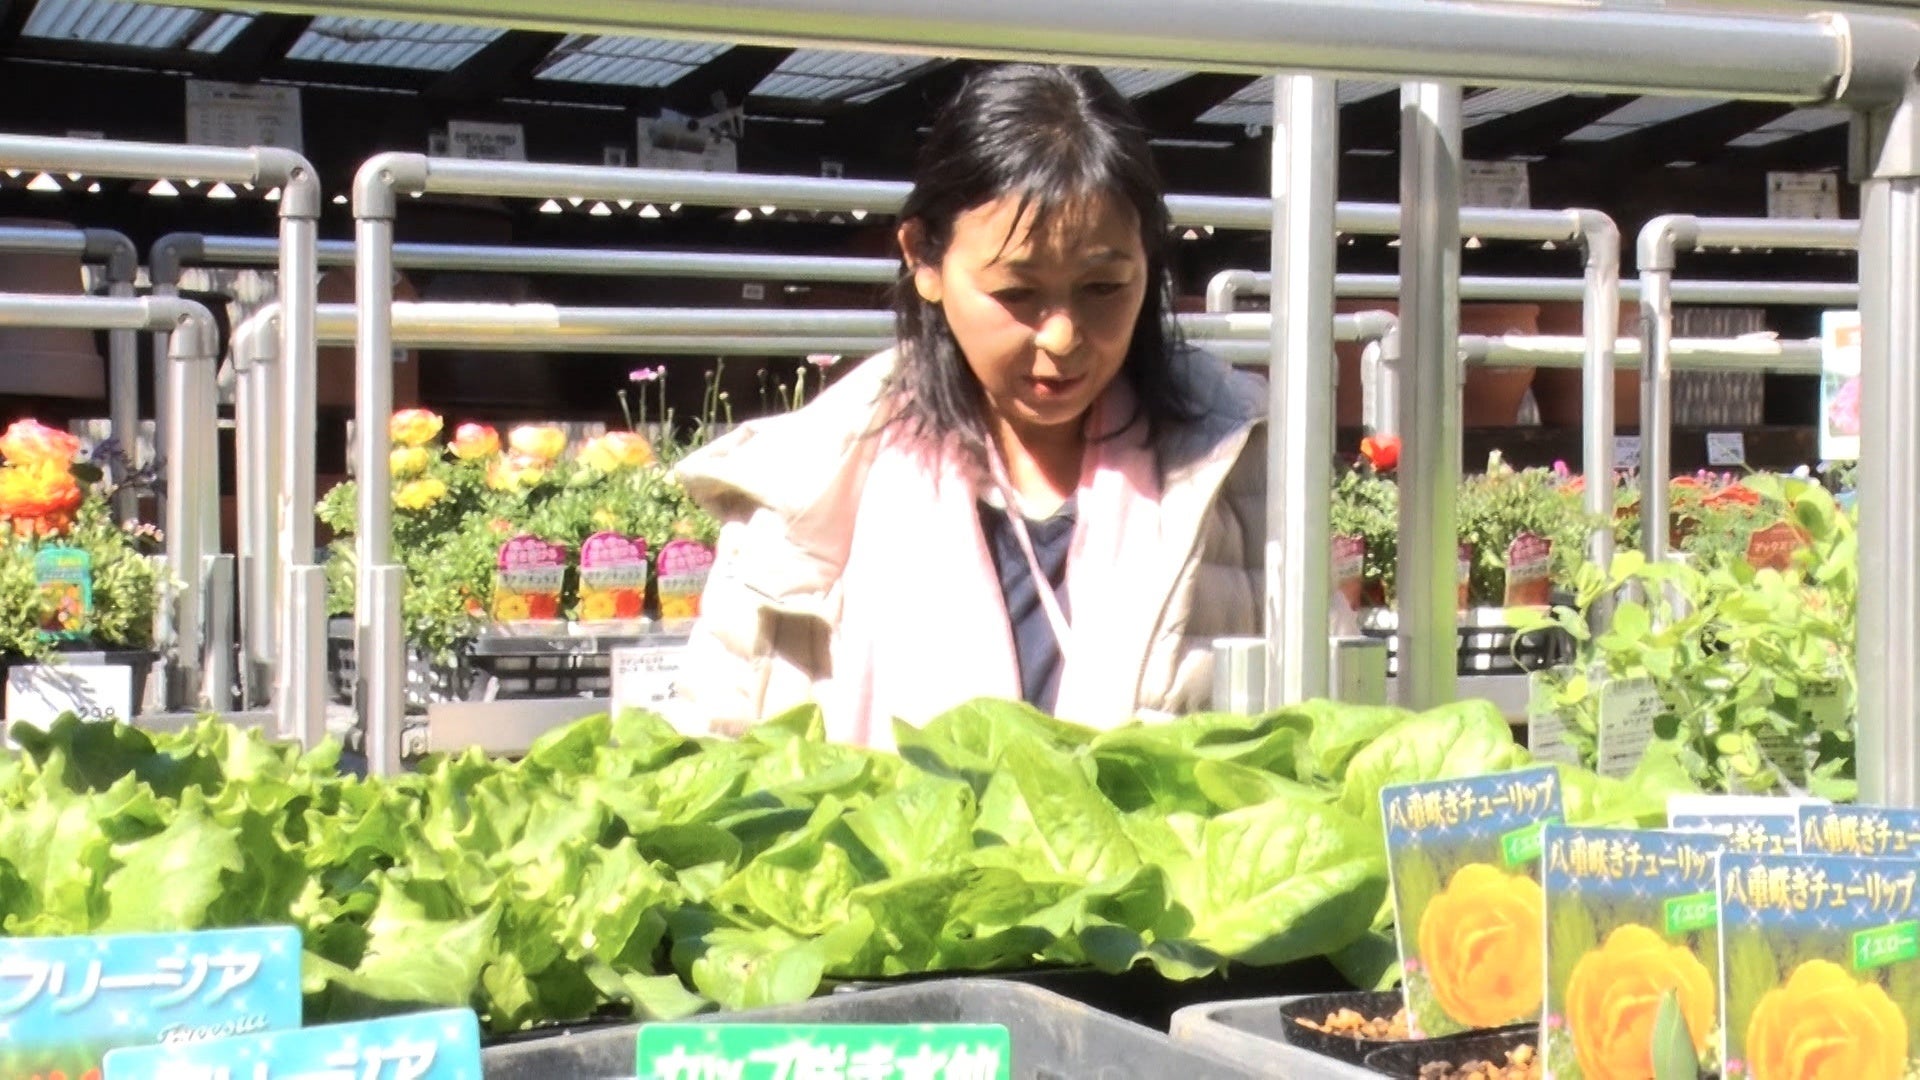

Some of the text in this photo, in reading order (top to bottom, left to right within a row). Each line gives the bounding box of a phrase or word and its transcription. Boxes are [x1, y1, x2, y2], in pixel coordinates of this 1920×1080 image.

[1390, 774, 1555, 834] 八重咲きチューリップ
[1725, 863, 1917, 911] 八重咲きチューリップ
[1861, 936, 1914, 959] イエロー
